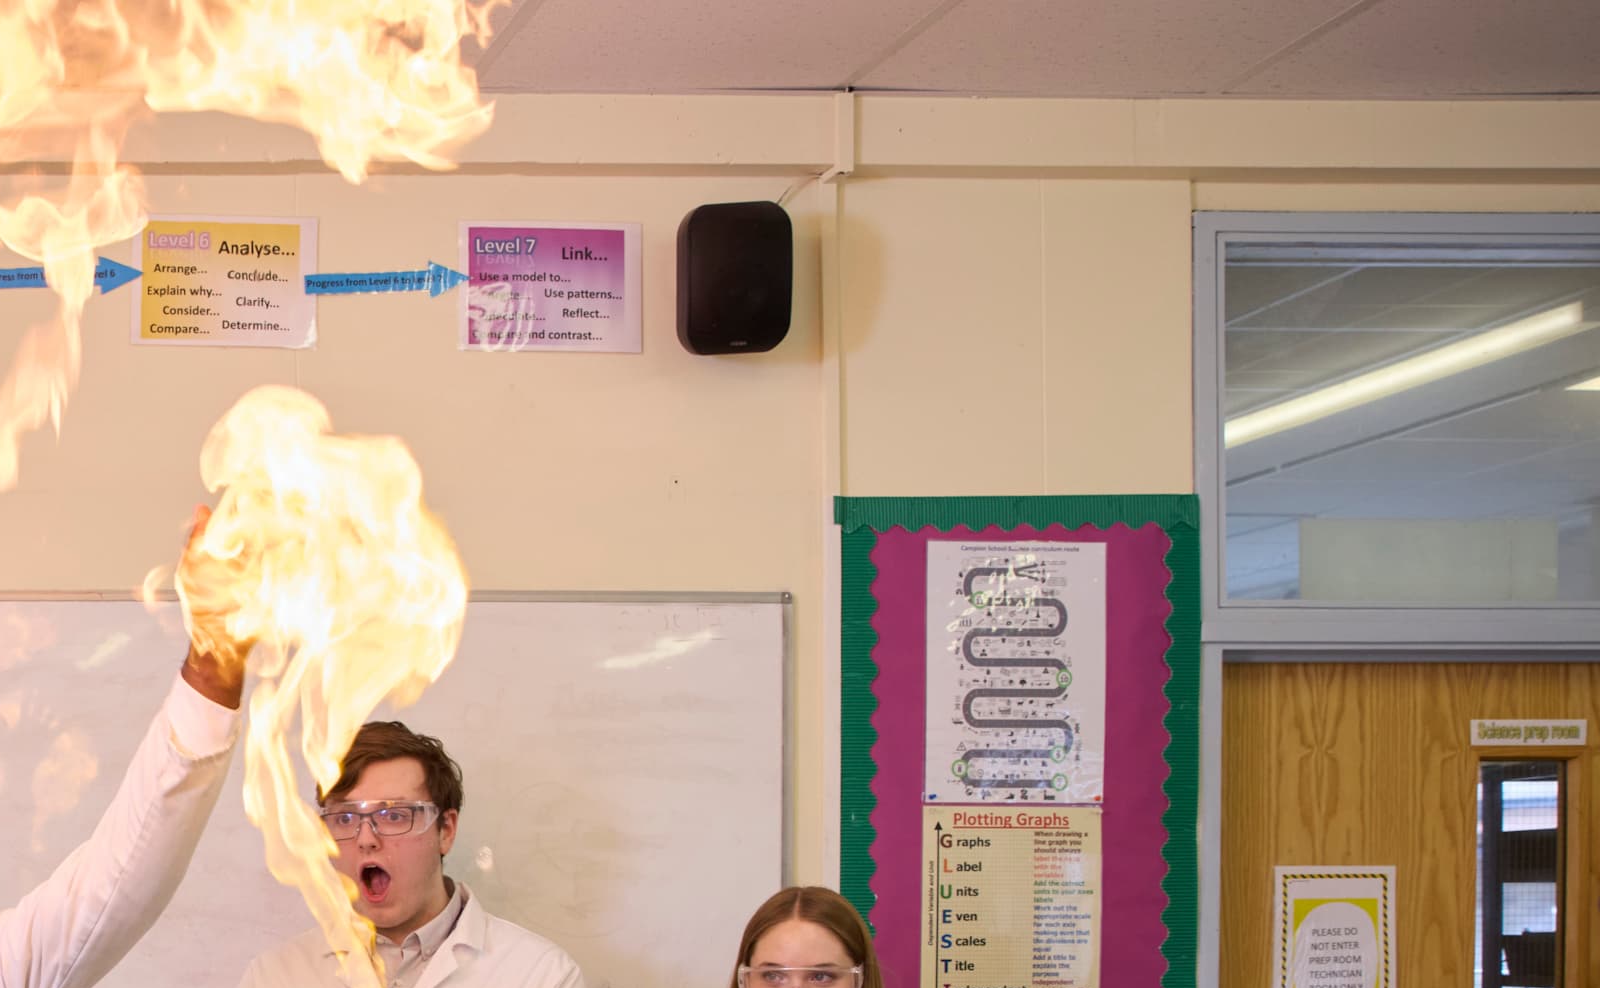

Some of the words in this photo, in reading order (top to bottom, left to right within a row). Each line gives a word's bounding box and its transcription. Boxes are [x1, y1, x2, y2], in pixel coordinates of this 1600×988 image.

[149, 231, 195, 249] Level
[200, 232, 211, 249] 6
[475, 238, 521, 254] Level
[526, 238, 537, 254] 7
[219, 240, 295, 258] Analyse...
[562, 247, 608, 262] Link...
[17, 271, 38, 281] from
[110, 269, 116, 279] 6
[154, 263, 208, 276] Arrange...
[227, 270, 288, 283] Conclude...
[307, 278, 348, 289] Progress
[349, 277, 367, 287] from
[369, 276, 392, 286] Level
[479, 272, 500, 282] Use
[502, 274, 509, 282] a
[512, 272, 546, 282] model
[549, 273, 571, 282] to...
[147, 285, 186, 297] Explain
[190, 286, 222, 297] why...
[544, 288, 565, 299] Use
[567, 289, 623, 300] patterns...
[236, 296, 280, 309] Clarify...
[162, 305, 220, 317] Consider...
[562, 307, 610, 319] Reflect...
[150, 323, 210, 336] Compare...
[222, 319, 290, 332] Determine...
[548, 330, 603, 341] contrast...
[1477, 721, 1522, 739] Science
[1523, 725, 1549, 743] prep
[1551, 725, 1579, 740] room
[953, 812, 1013, 829] Plotting
[1016, 812, 1070, 829] Graphs
[940, 833, 953, 849] G
[956, 837, 991, 850] raphs
[943, 858, 953, 873] L
[956, 861, 982, 872] abel
[940, 884, 953, 899] U
[956, 886, 980, 897] nits
[942, 909, 953, 924] E
[956, 912, 978, 921] ven
[1311, 928, 1341, 936] PLEASE
[1344, 927, 1358, 936] DO
[940, 934, 953, 949] S
[955, 936, 987, 947] cales
[1311, 942, 1330, 951] NOT
[1331, 941, 1360, 950] ENTER
[940, 959, 953, 974] T
[955, 960, 975, 971] itle
[1308, 957, 1331, 965] PREP
[1332, 955, 1362, 964] ROOM
[1309, 969, 1363, 979] TECHNICIAN
